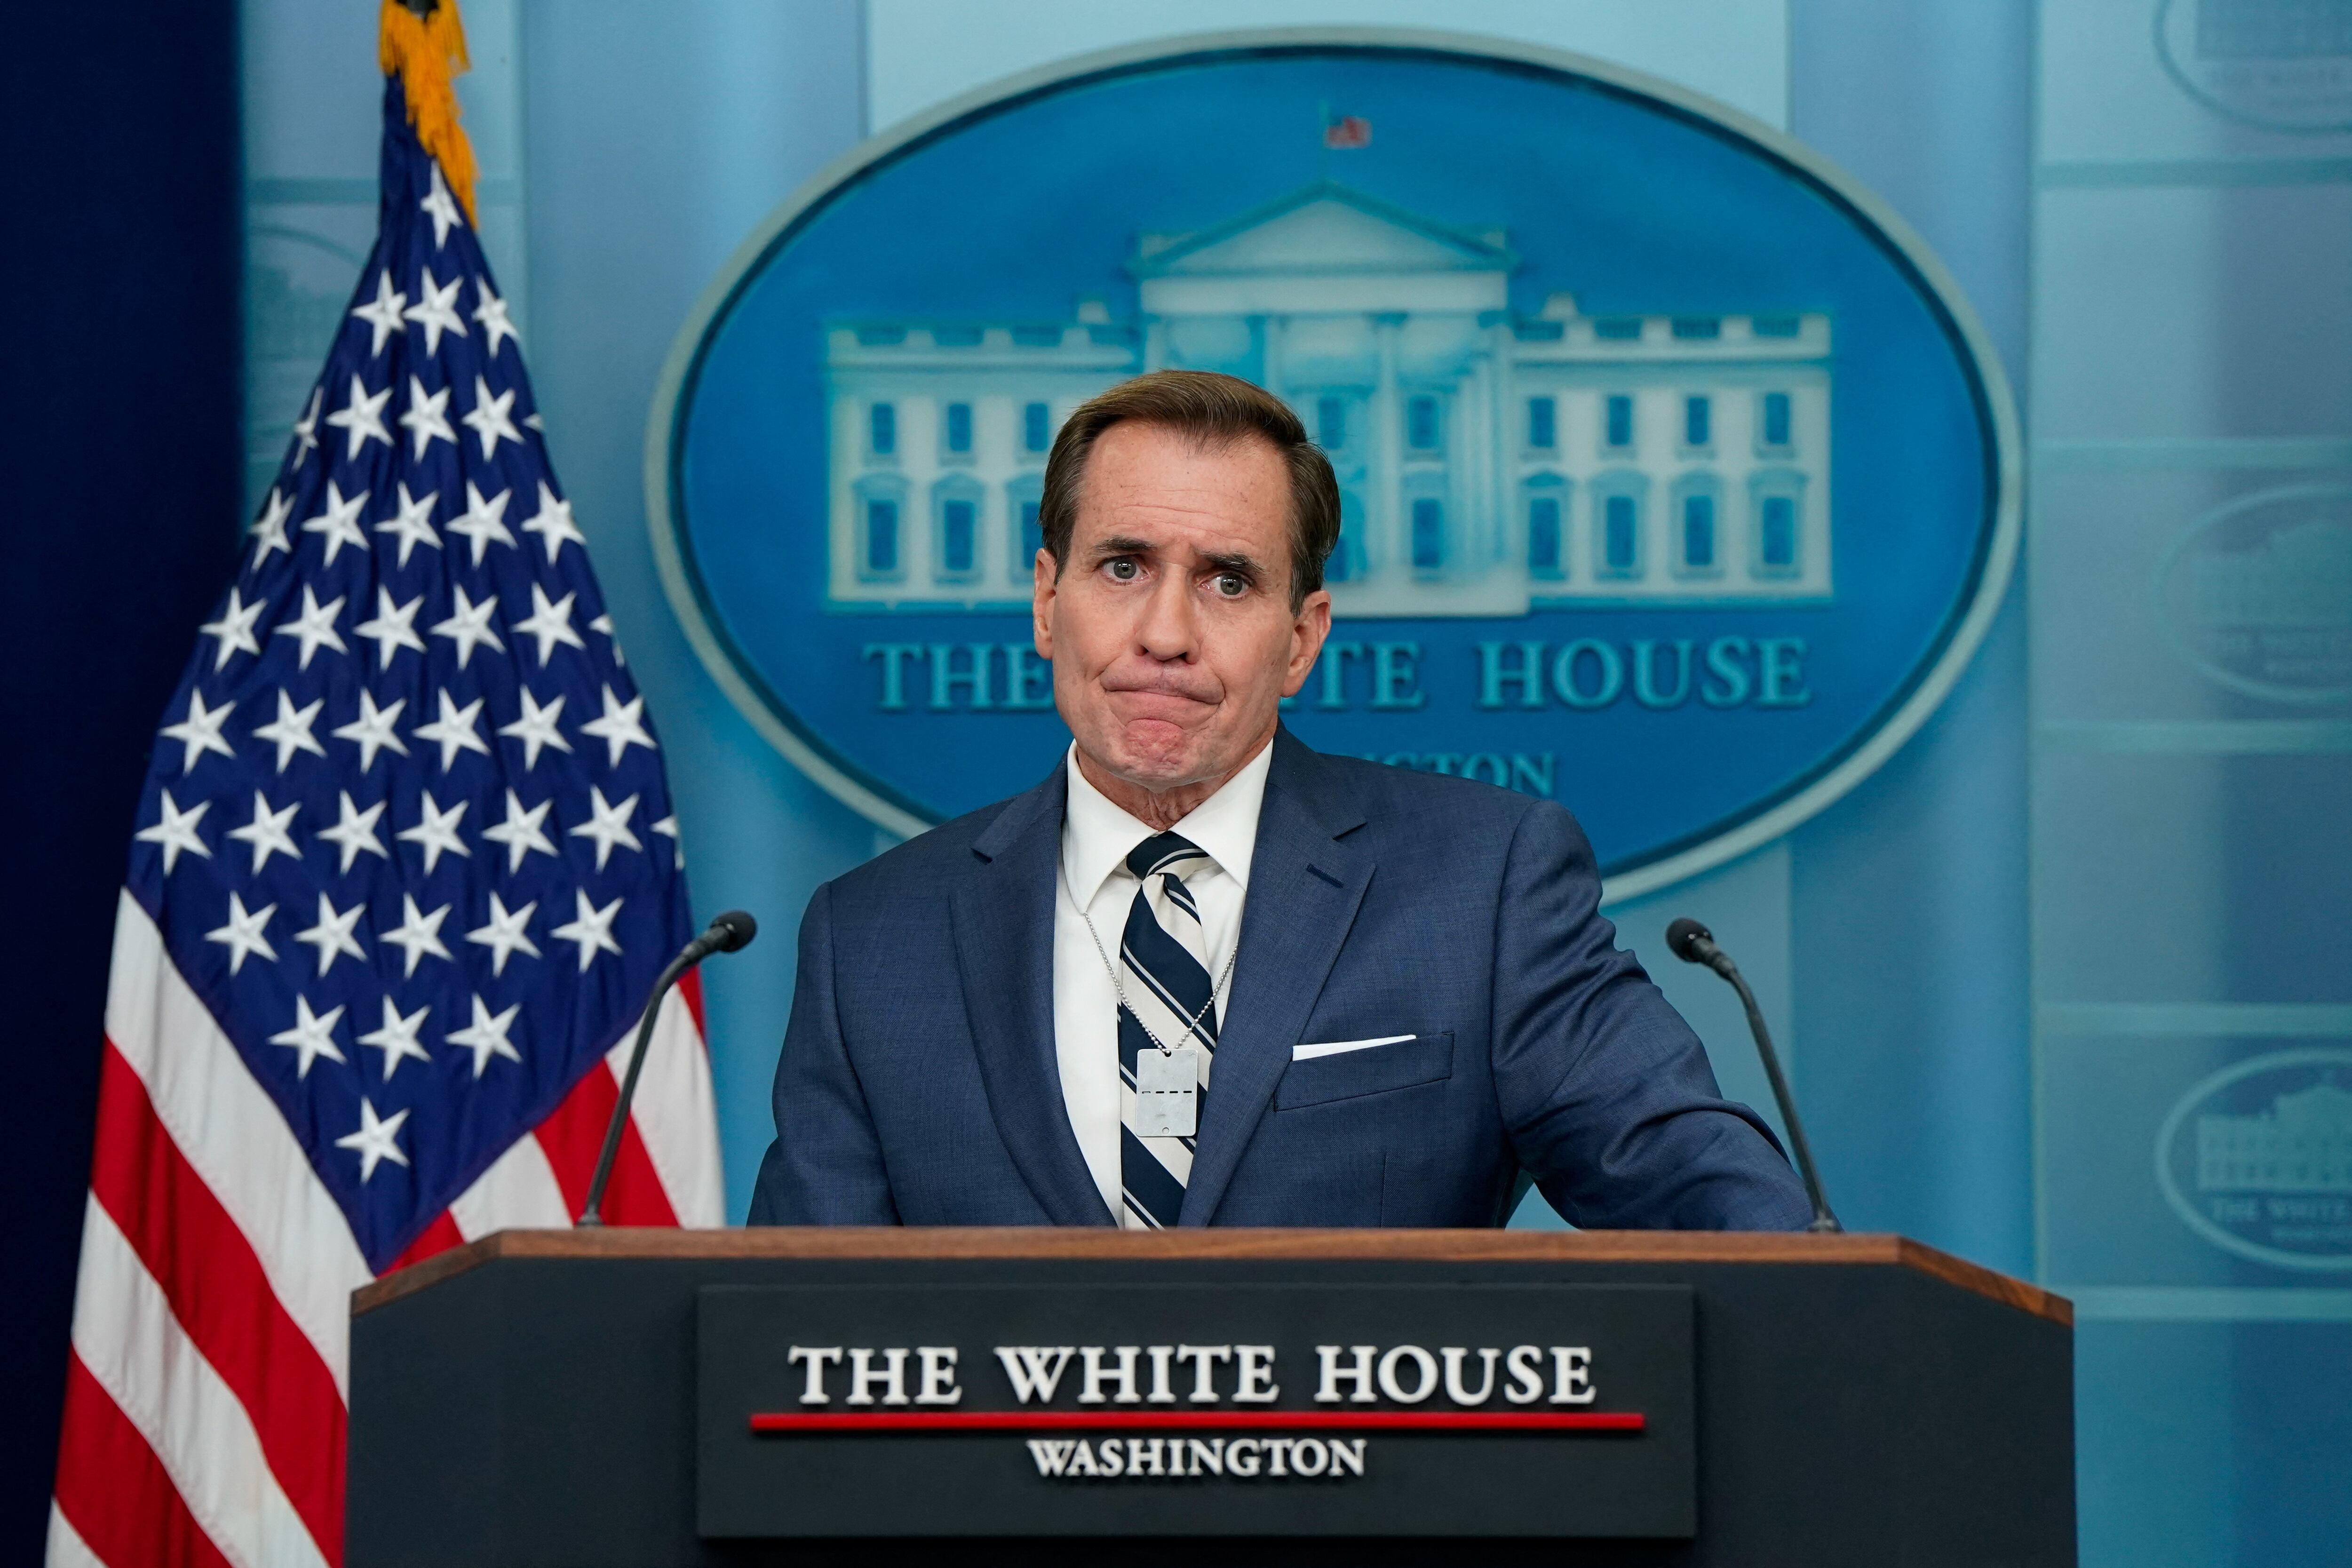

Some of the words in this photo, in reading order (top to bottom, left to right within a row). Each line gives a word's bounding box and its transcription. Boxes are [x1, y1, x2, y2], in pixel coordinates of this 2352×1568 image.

[862, 642, 1055, 708] THE
[1477, 635, 1812, 707] HOUSE
[787, 1345, 962, 1405] THE
[993, 1344, 1280, 1403] WHITE
[1313, 1345, 1597, 1406] HOUSE
[1027, 1438, 1367, 1477] WASHINGTON
